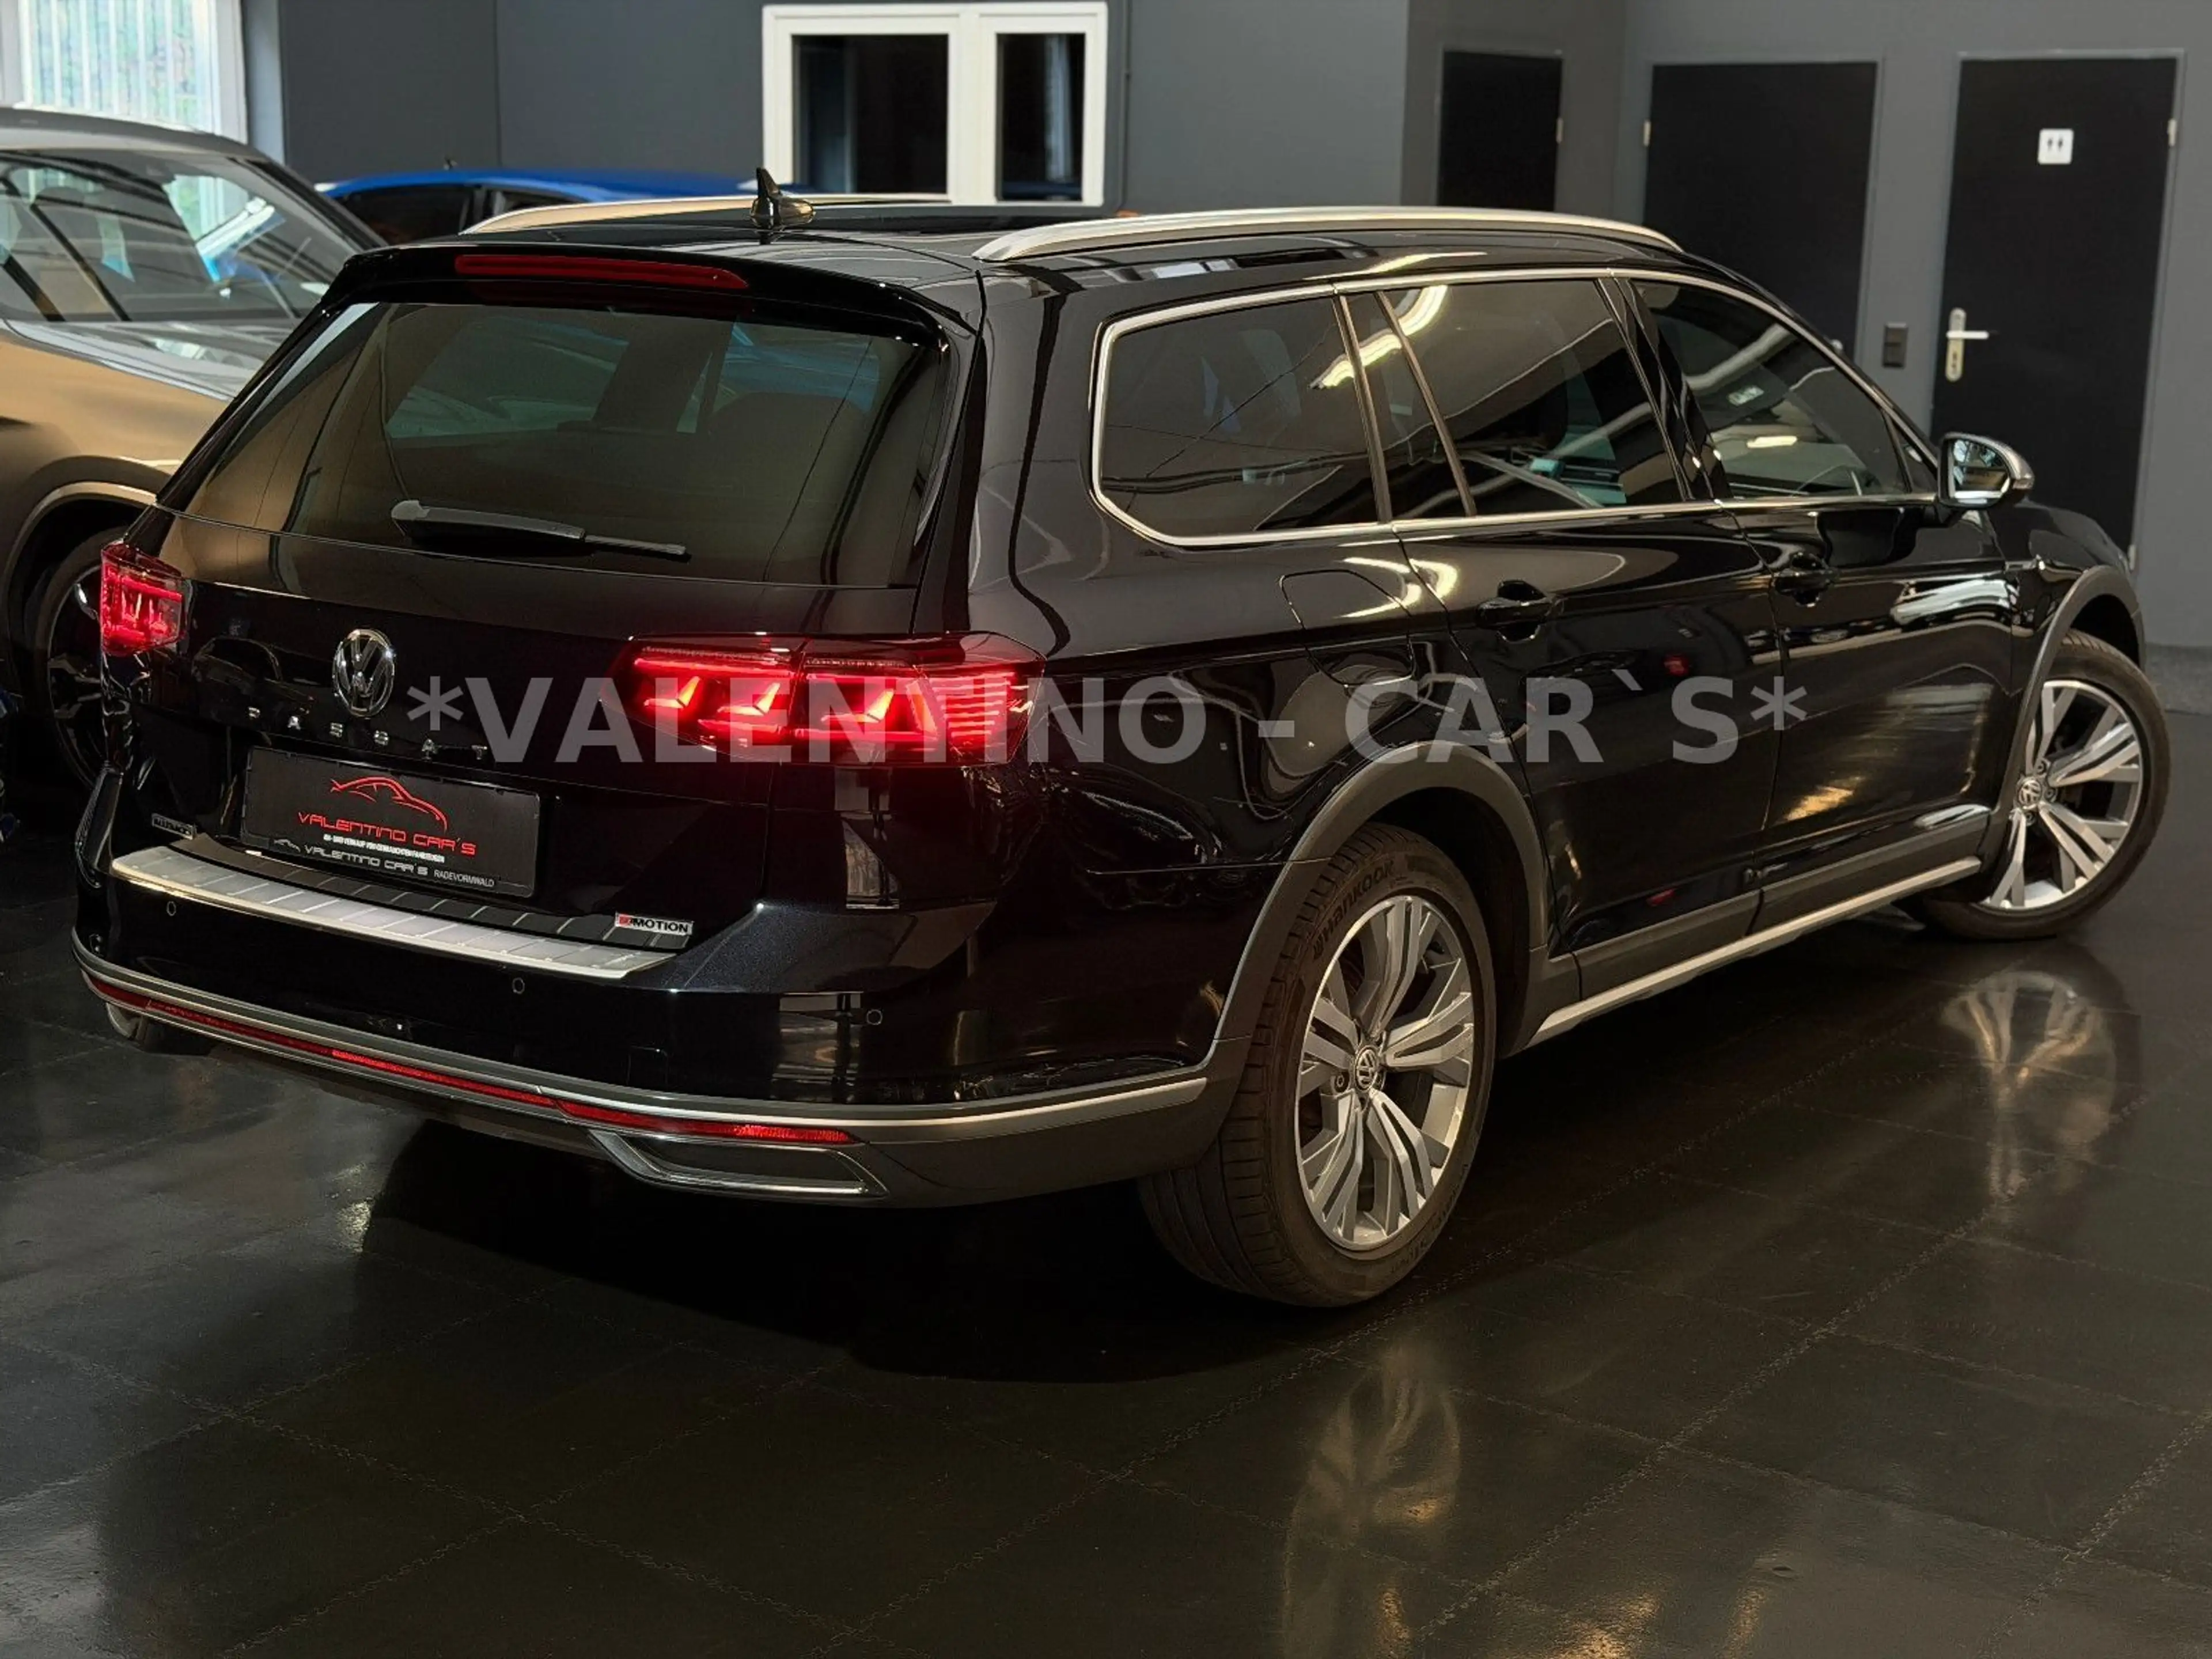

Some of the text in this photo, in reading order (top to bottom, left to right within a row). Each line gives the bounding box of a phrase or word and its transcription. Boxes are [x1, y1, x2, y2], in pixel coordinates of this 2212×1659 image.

[248, 706, 488, 761] PASSAT
[298, 812, 406, 842] VALENTINO
[304, 844, 380, 867] VALENTINO
[433, 869, 495, 888] RADEVORMWALD
